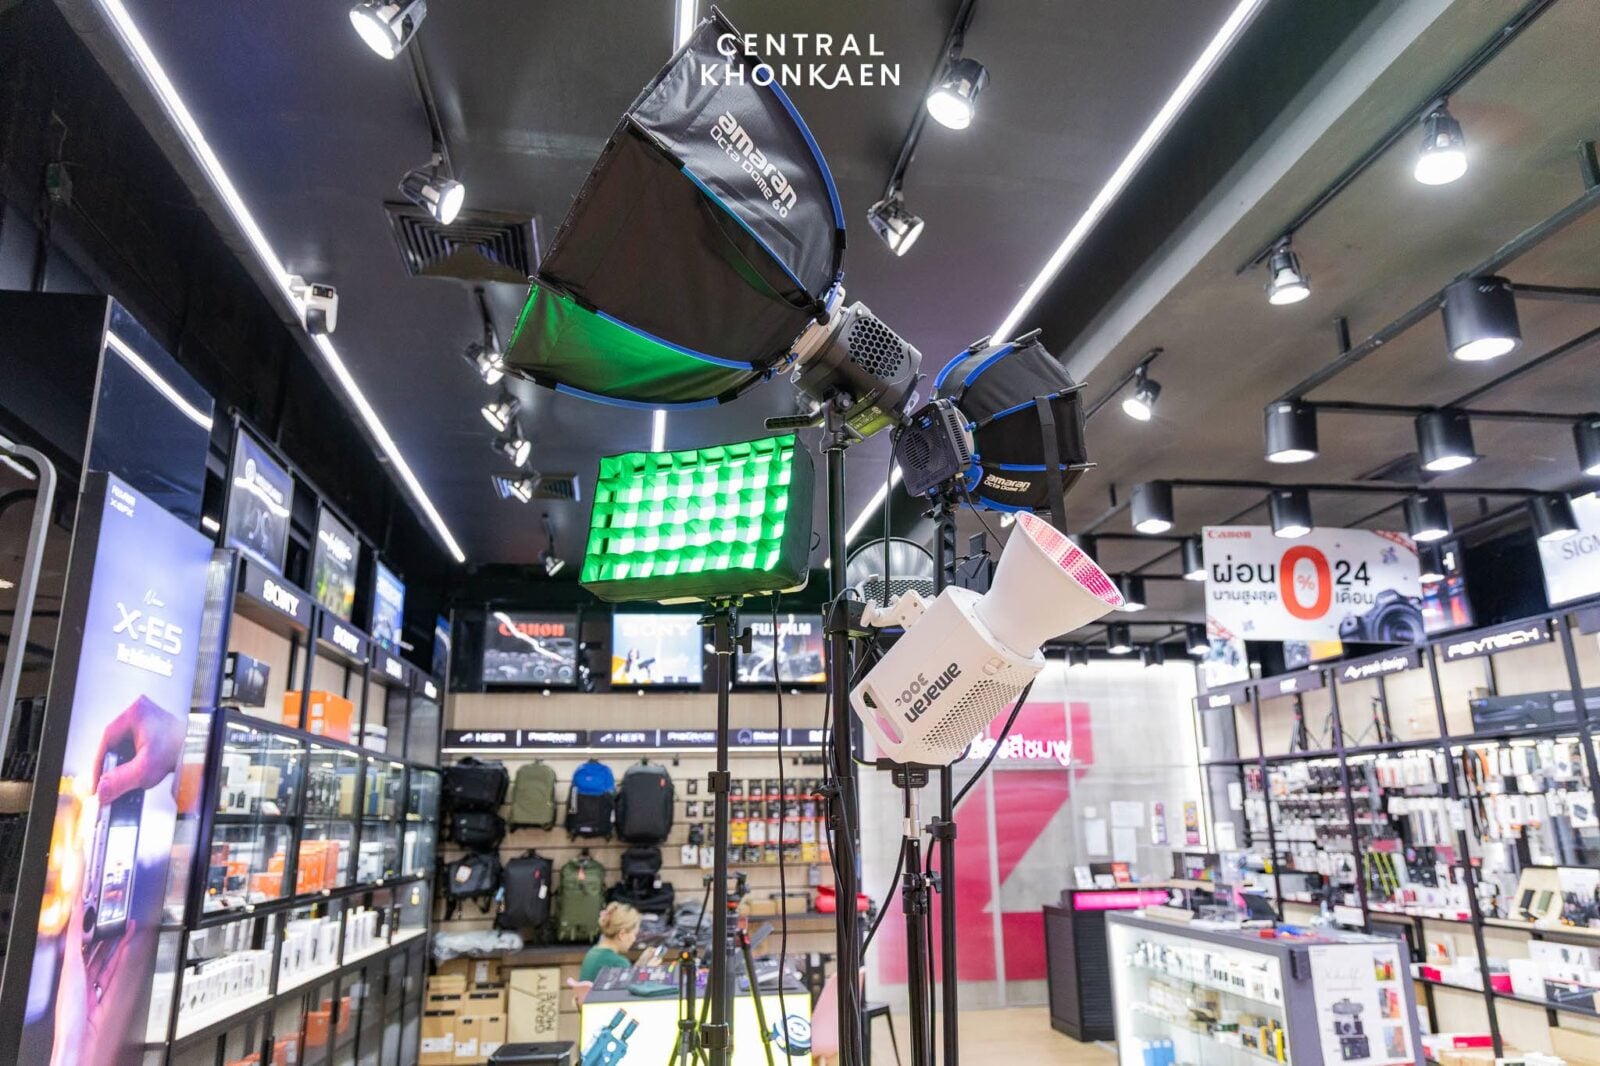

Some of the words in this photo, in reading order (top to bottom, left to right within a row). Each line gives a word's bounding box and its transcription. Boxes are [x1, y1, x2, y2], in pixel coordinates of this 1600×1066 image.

[710, 125, 740, 162] Octa
[742, 160, 773, 200] Dome
[772, 199, 788, 218] 60
[718, 110, 797, 210] amaran
[986, 473, 1031, 488] amaran
[1207, 530, 1251, 539] Canon
[1213, 555, 1275, 584] ผ่อน
[1335, 560, 1370, 586] 24
[262, 579, 299, 617] SONY
[1336, 586, 1375, 605] เดือน
[112, 602, 183, 656] X-E5
[498, 623, 565, 637] Canon
[622, 622, 691, 637] SONY
[904, 663, 962, 723] amaran
